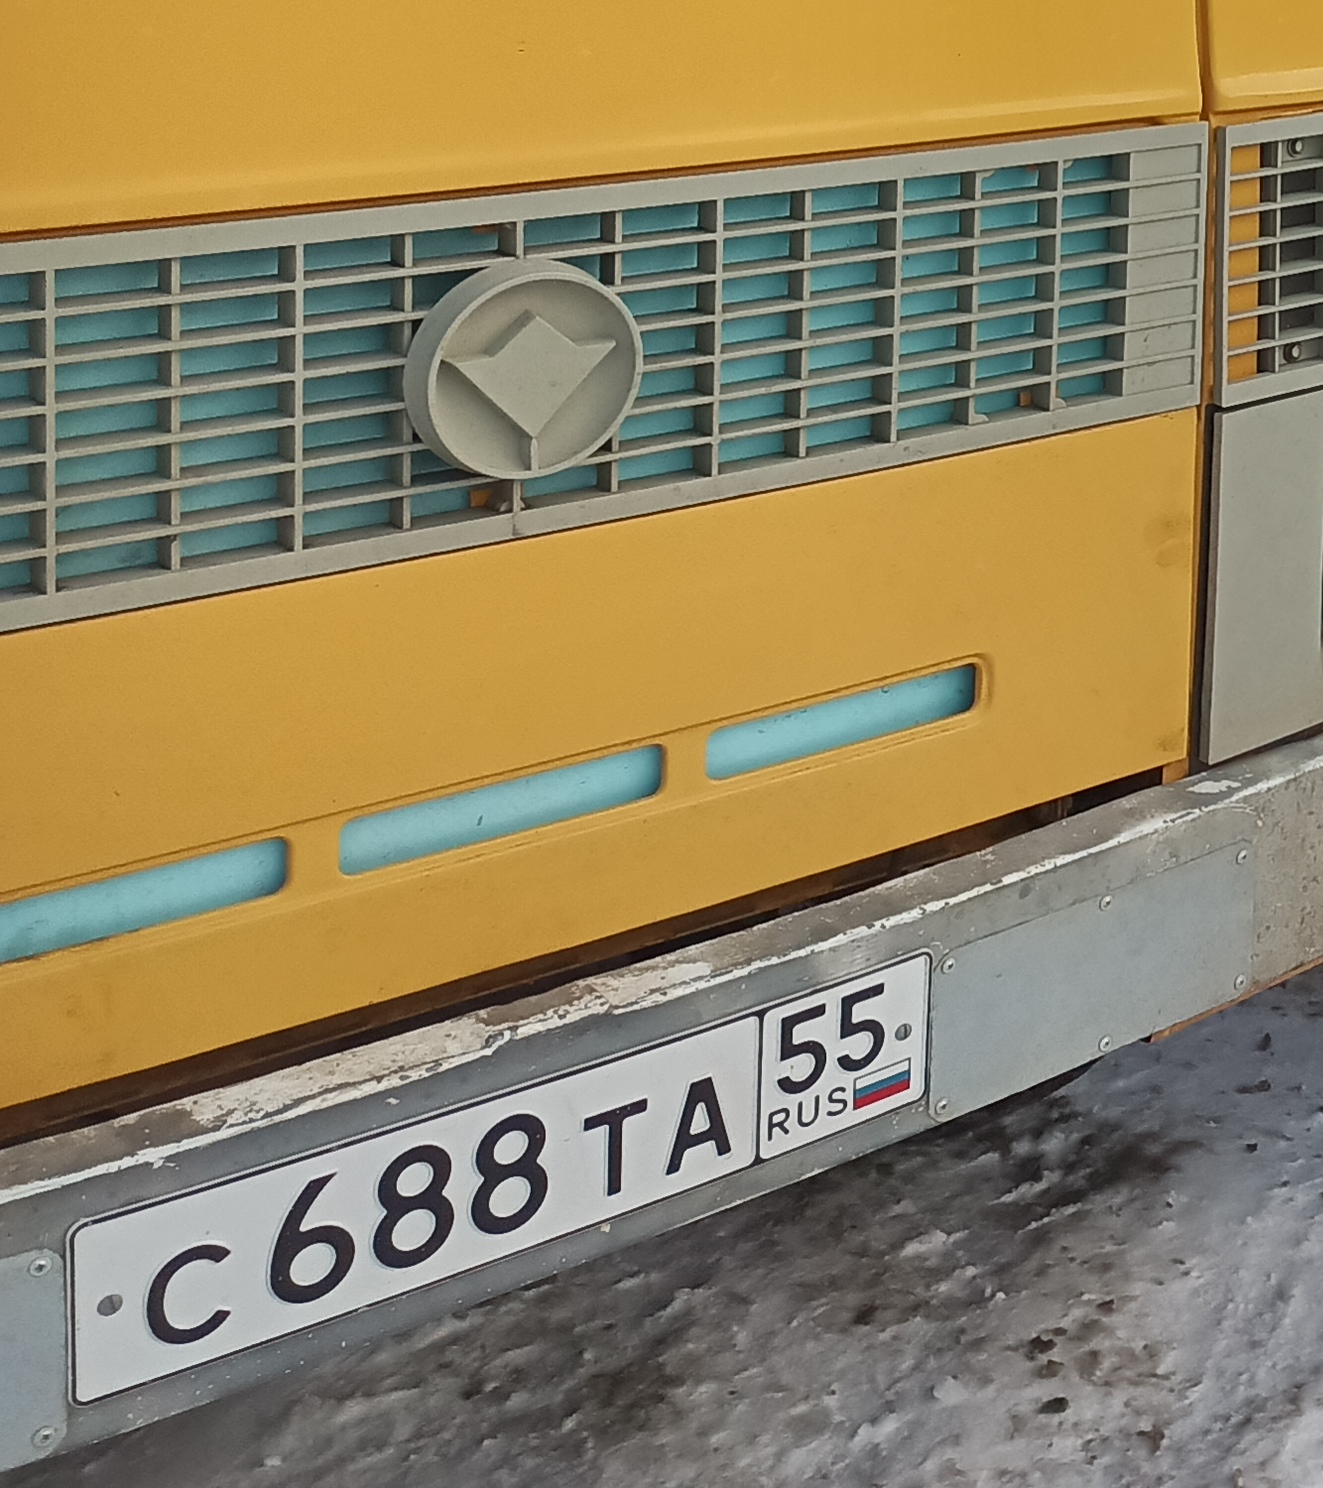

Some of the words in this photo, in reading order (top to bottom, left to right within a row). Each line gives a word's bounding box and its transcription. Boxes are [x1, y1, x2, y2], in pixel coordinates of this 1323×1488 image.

[145, 1075, 732, 1345] С688ТА
[775, 982, 886, 1095] 55
[766, 1085, 850, 1142] RUS
